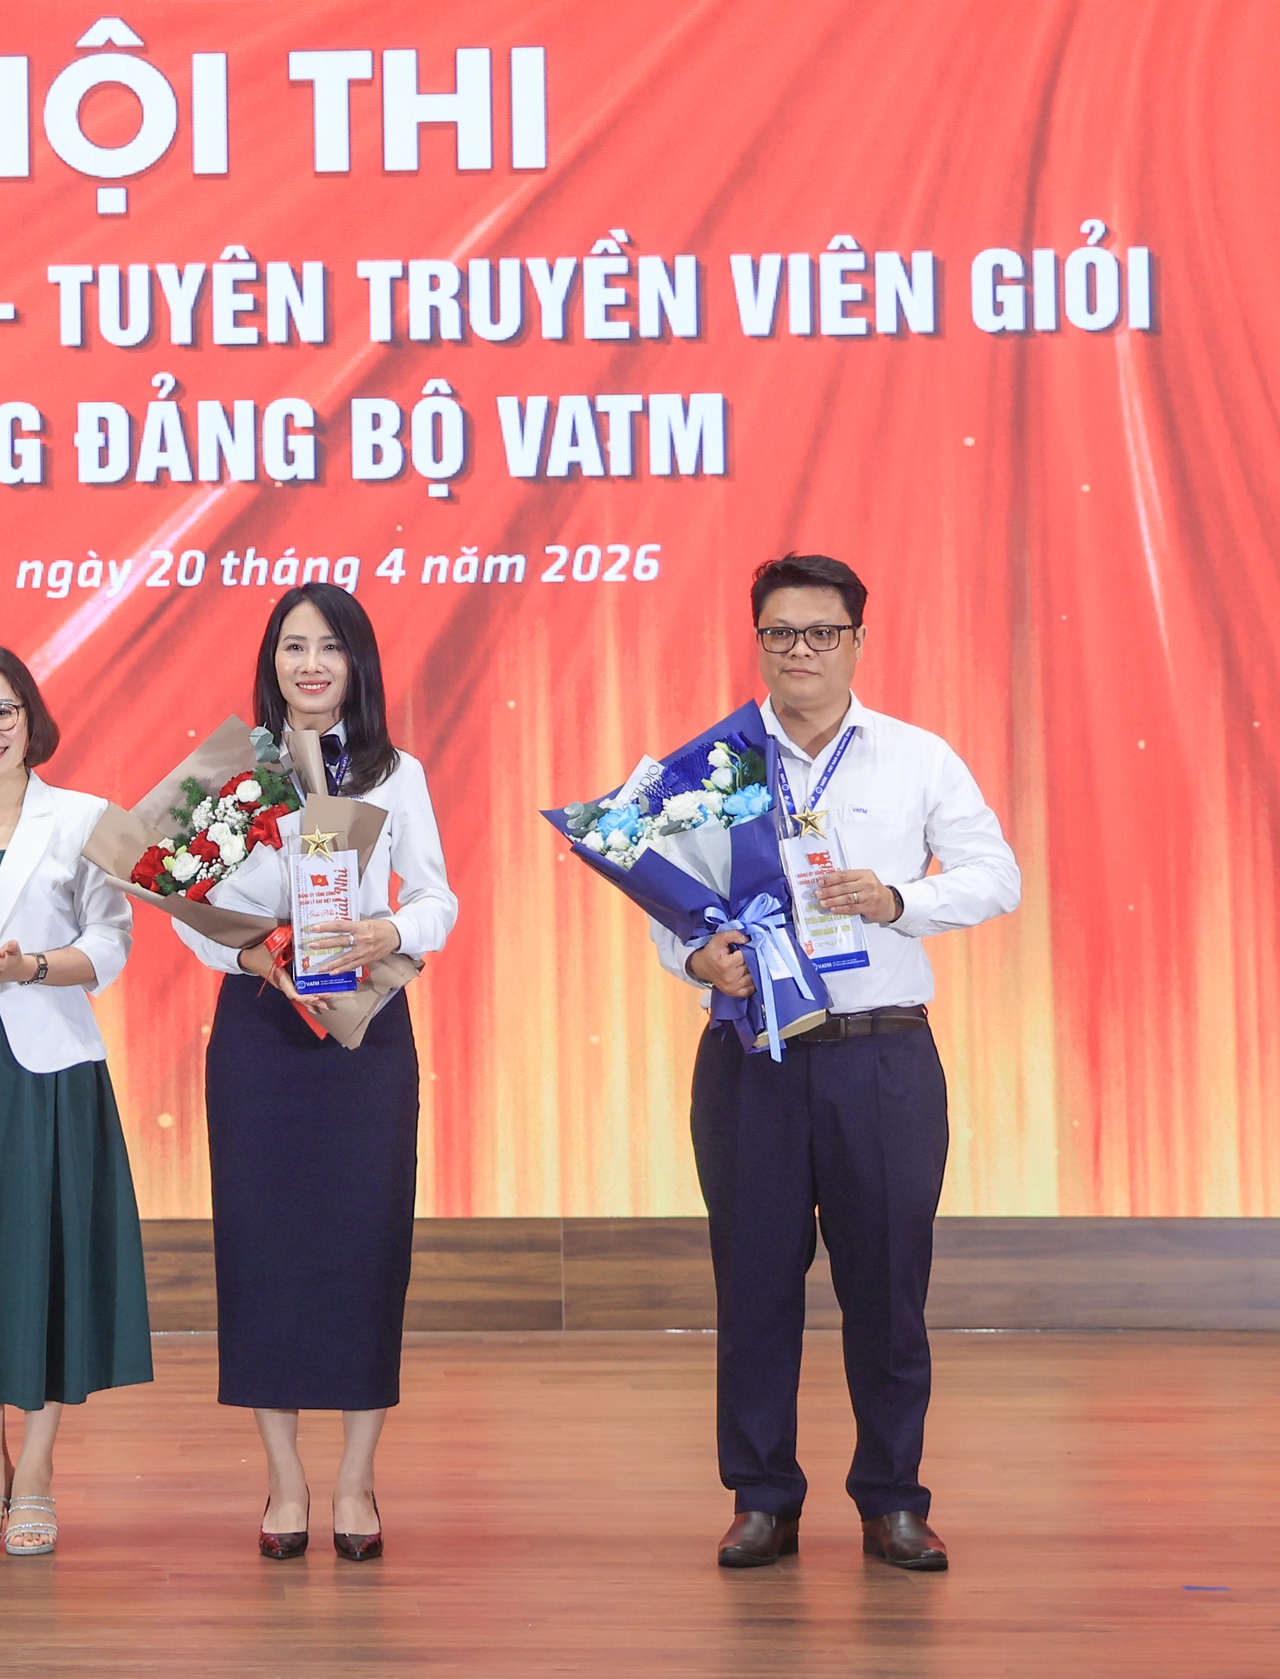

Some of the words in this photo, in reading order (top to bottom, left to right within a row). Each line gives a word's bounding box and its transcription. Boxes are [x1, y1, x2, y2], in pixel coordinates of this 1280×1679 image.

[288, 46, 548, 173] THI
[47, 244, 326, 348] TUYÊN
[356, 229, 699, 345] TRUYỀN
[729, 234, 936, 338] VIÊN
[971, 218, 1152, 335] GIỎI
[73, 372, 317, 486] ĐẢNG
[351, 378, 466, 498] BỘ
[496, 392, 726, 478] VATM
[16, 549, 133, 600] ngày
[144, 548, 206, 588] 20
[220, 547, 361, 595] tháng
[375, 547, 407, 585] 4
[420, 546, 527, 585] năm
[540, 543, 662, 584] 2026
